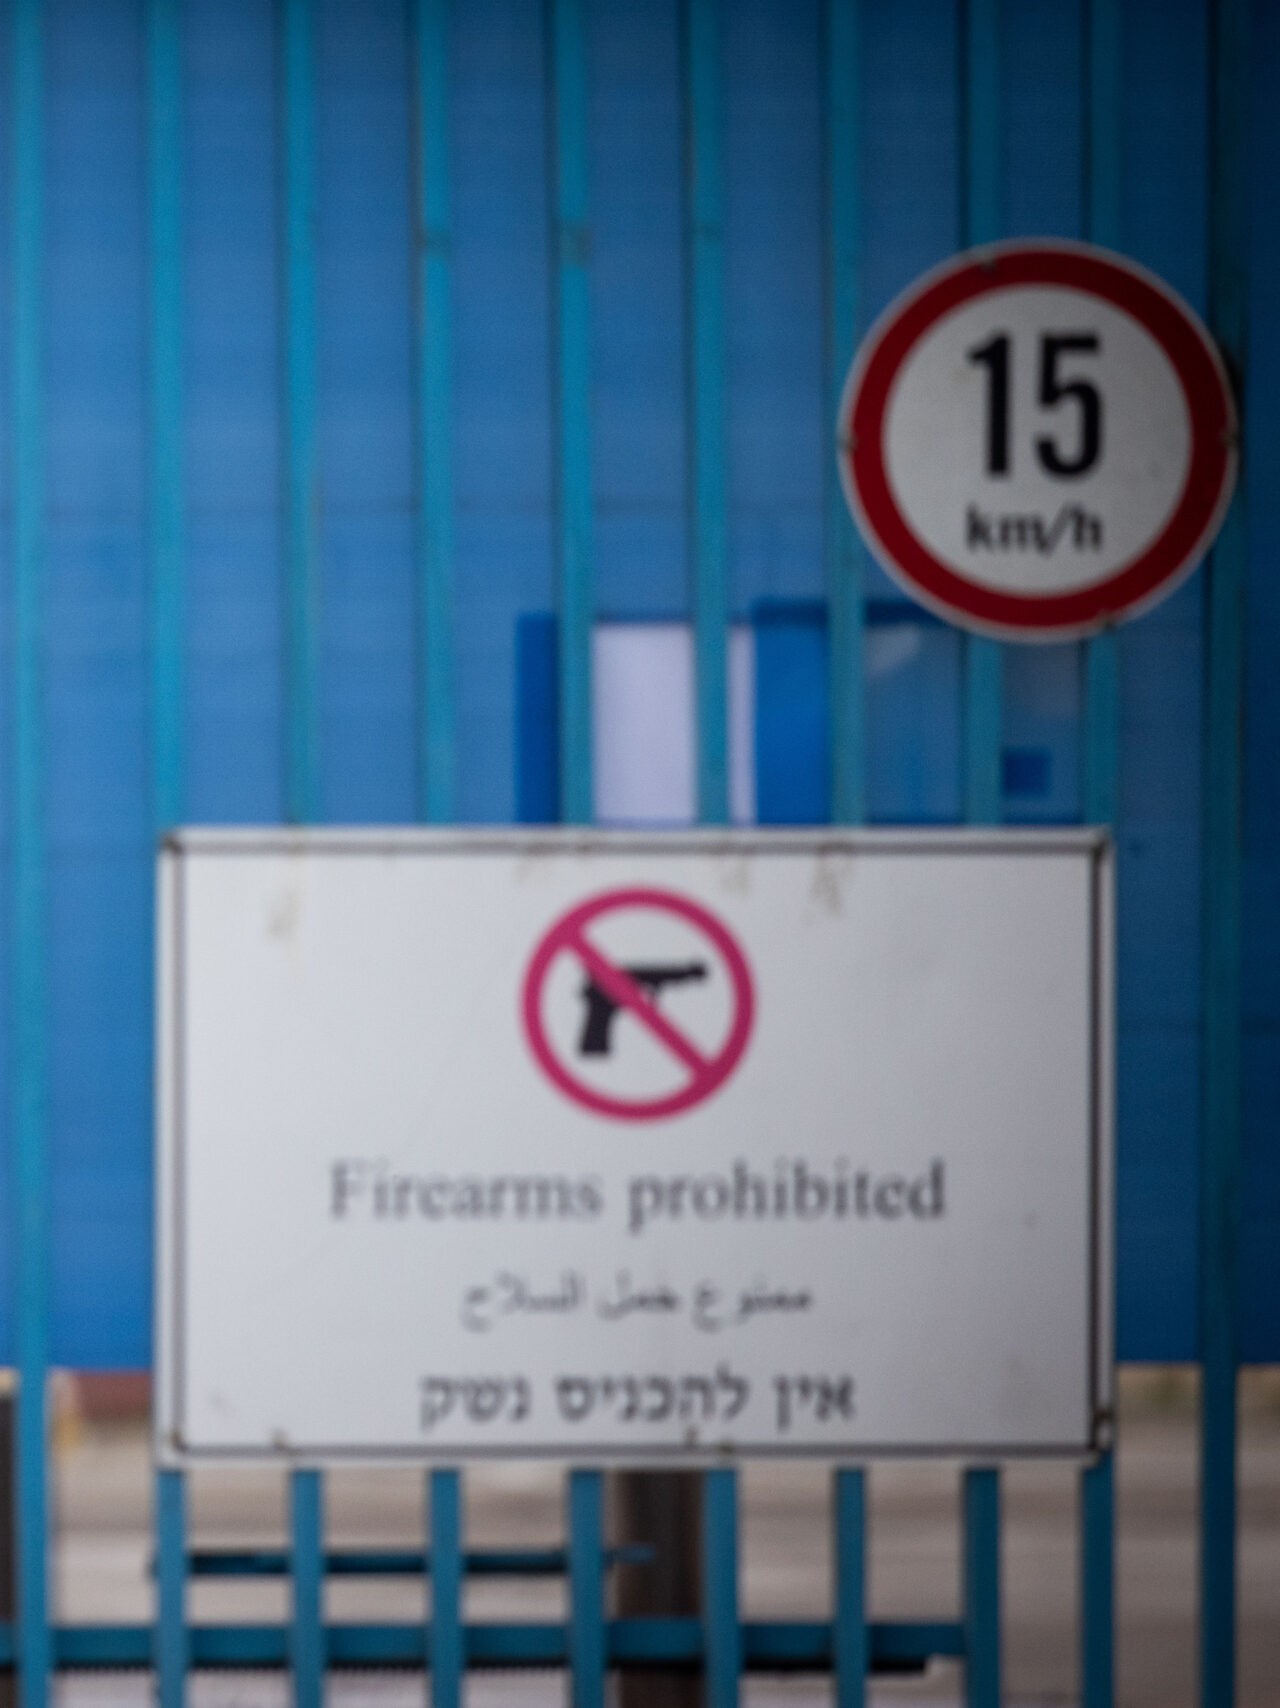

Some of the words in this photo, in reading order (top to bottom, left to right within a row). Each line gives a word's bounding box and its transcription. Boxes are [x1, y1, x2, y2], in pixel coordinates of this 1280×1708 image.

[965, 328, 1103, 482] 15
[965, 504, 1104, 556] km/h
[331, 1158, 605, 1222] Firearms
[628, 1158, 944, 1236] prohibited
[420, 1375, 532, 1430] נשק
[554, 1363, 751, 1423] להכניס
[774, 1374, 856, 1430] אין
